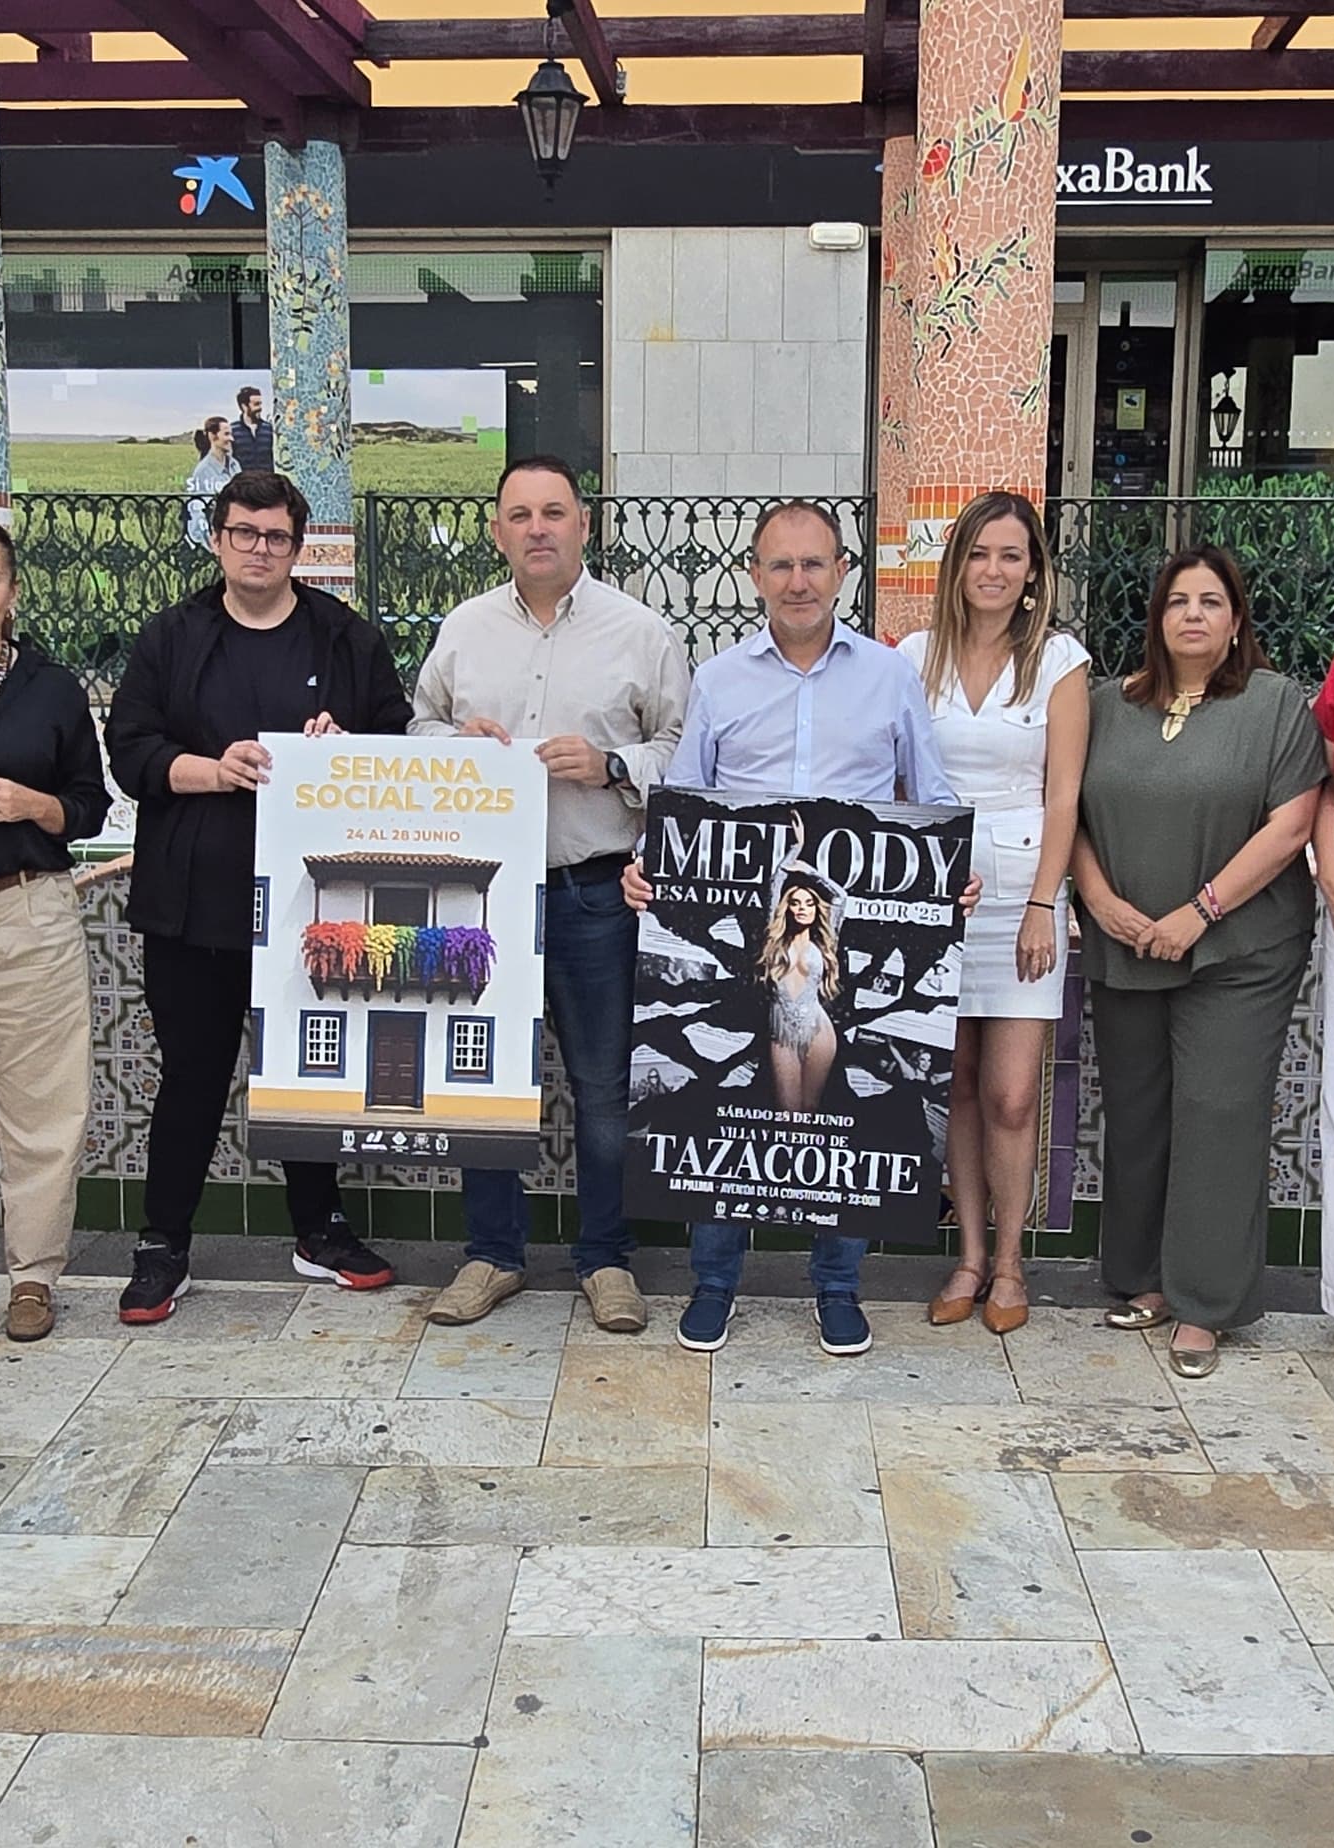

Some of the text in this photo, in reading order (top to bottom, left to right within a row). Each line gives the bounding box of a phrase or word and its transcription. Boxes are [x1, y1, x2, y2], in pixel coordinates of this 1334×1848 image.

[1055, 146, 1213, 193] xaBank
[167, 263, 269, 288] AgroBan
[330, 755, 482, 785] SEMANA
[295, 783, 516, 814] SOCIAL 2025
[346, 828, 461, 842] 24 AL 28 JUNIO
[654, 882, 764, 909] ESA DIVA
[854, 900, 942, 922] TOUR '25
[716, 1104, 855, 1128] SÁBADO 28 DE JUNIO
[719, 1125, 849, 1148] VILLA Y PUERTO DE
[645, 1132, 921, 1195] TAZACORTE
[669, 1178, 681, 1191] LA
[682, 1179, 715, 1193] PALMA
[757, 1185, 768, 1197] DE
[769, 1186, 780, 1198] LA
[780, 1187, 842, 1204] CONSTITUCIÓN
